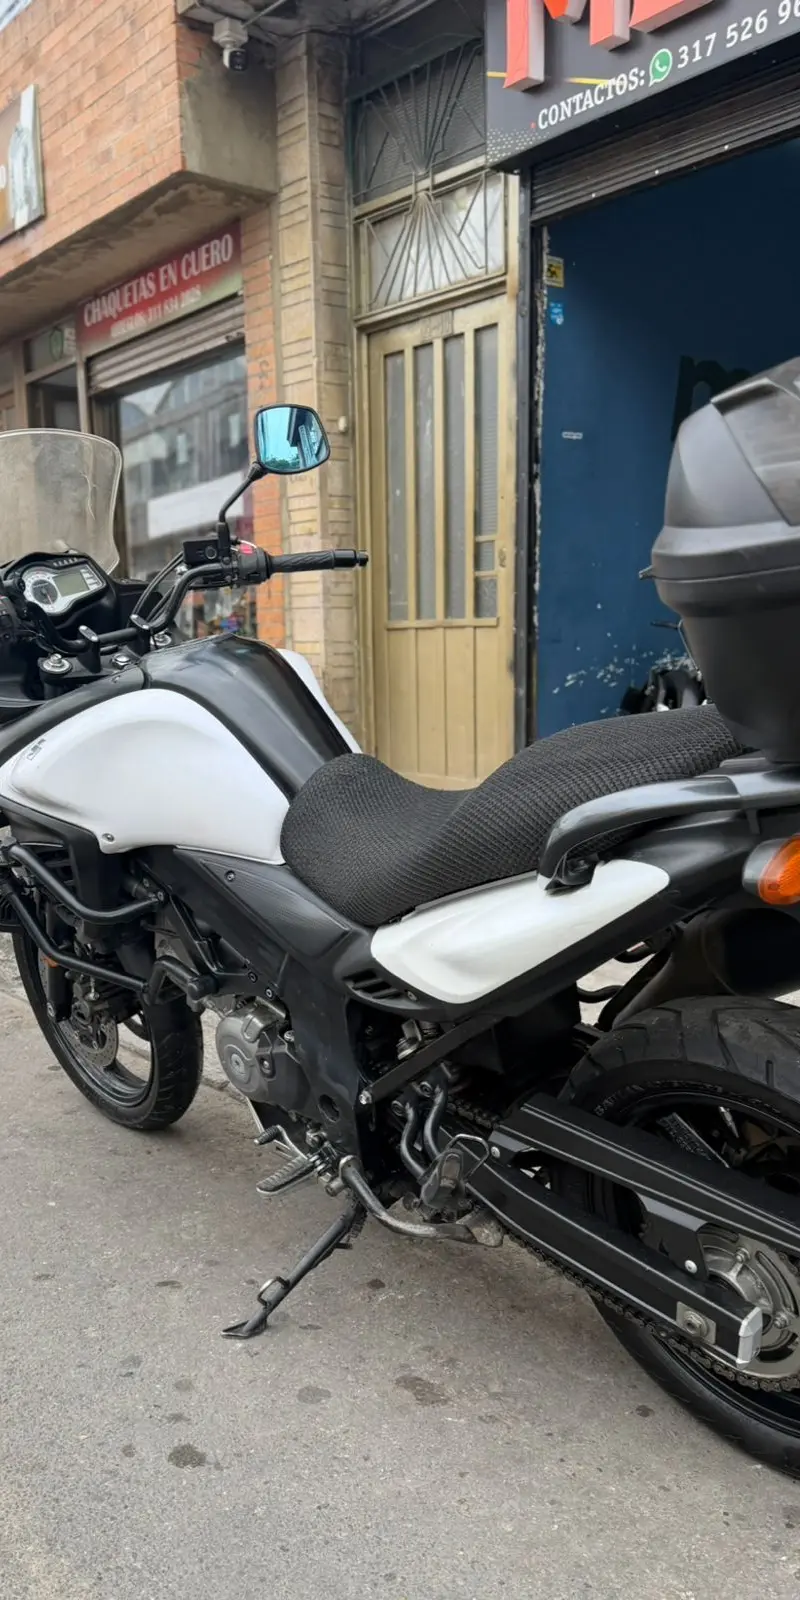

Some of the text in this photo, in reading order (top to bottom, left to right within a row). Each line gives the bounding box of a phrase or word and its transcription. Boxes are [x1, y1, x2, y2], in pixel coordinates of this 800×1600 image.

[537, 67, 646, 130] CONTACTOS:
[677, 32, 717, 69] 317
[725, 9, 768, 49] 526
[84, 272, 156, 327] CHAQUETAS
[158, 260, 178, 292] EN
[181, 233, 233, 281] CUERO
